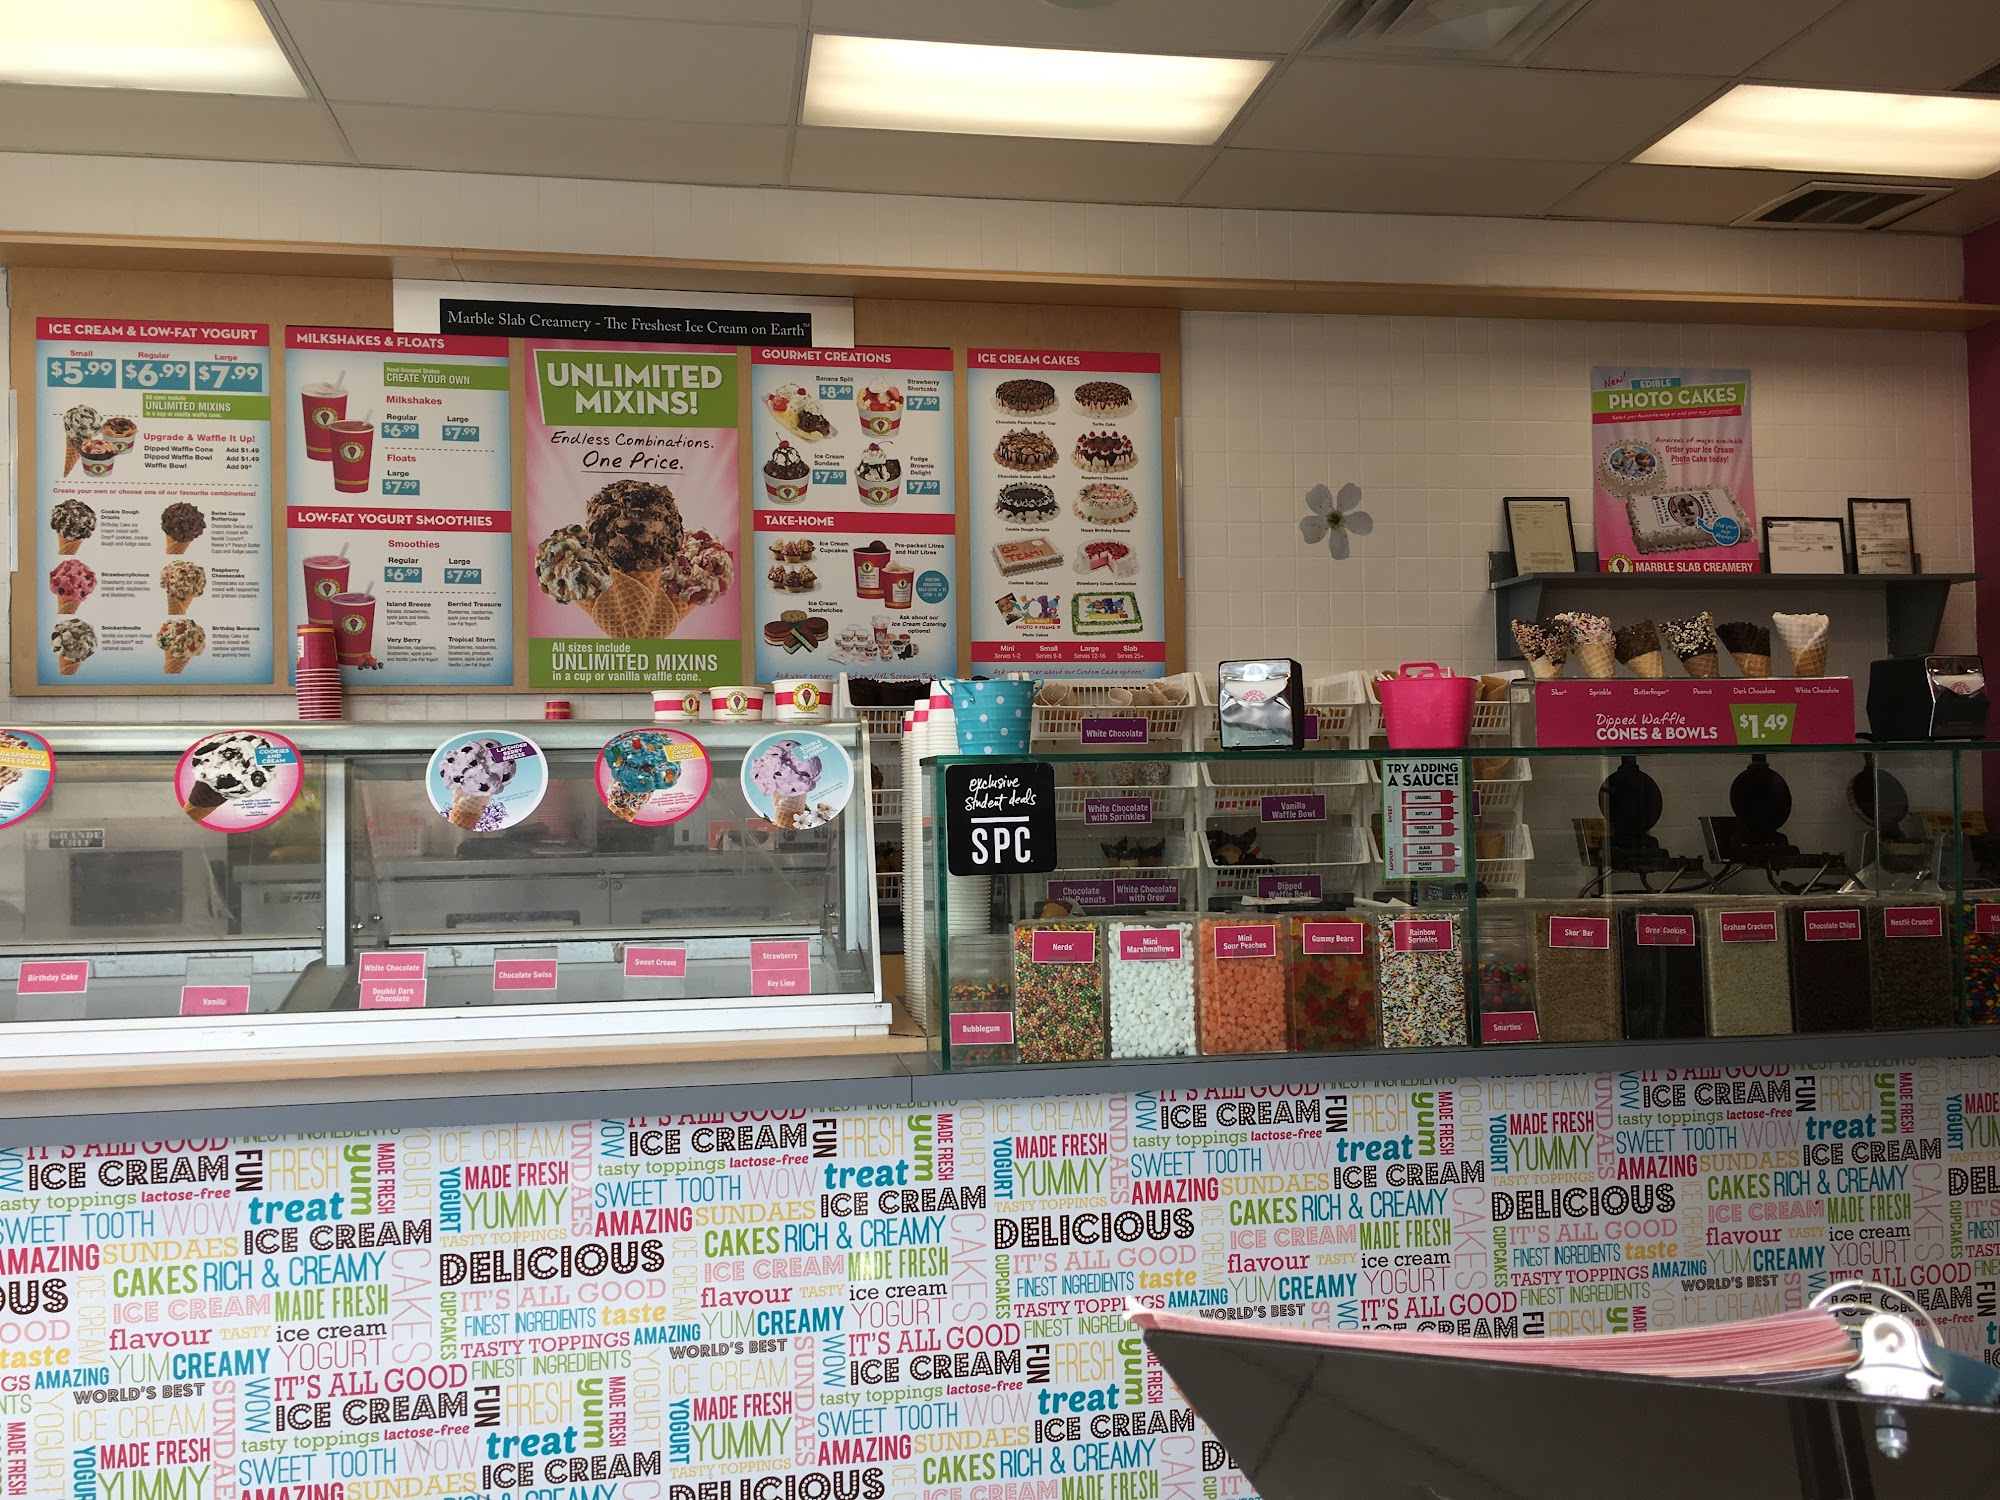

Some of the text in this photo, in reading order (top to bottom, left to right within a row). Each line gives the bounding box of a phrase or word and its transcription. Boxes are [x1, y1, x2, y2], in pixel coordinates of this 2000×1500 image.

[447, 310, 494, 326] Marble
[498, 313, 526, 326] Slab
[530, 314, 592, 332] Creamery
[604, 317, 628, 332] The
[632, 318, 682, 335] Freshest
[685, 320, 704, 334] Ice
[707, 321, 748, 336] Cream
[752, 326, 767, 336] on
[48, 324, 258, 340] ICE CREAM & LOW-FAT YOGURT
[297, 333, 445, 348] MILKSHAKES & FLOATS
[138, 351, 170, 360] Regular
[214, 354, 238, 362] Large
[762, 349, 892, 364] GOURMET CREATIONS
[978, 354, 1080, 366] ICE CREAM CAKES
[50, 360, 112, 385] $5.99
[125, 362, 188, 387] $6.99
[198, 364, 259, 389] $7.99
[548, 363, 722, 389] UNLIMITED
[386, 373, 470, 385] CREATE YOUR OWN
[908, 379, 940, 387] Strawberry
[1604, 371, 1627, 388] New!
[1640, 379, 1672, 389] EDIBLE
[820, 386, 852, 398] $8.49
[386, 395, 443, 405] Milkshakes
[575, 390, 698, 415] MIXINS!
[908, 398, 938, 410] $7.59
[1608, 387, 1737, 410] PHOTO CAKES
[386, 414, 417, 422] Regular
[447, 416, 469, 424] Large
[384, 425, 416, 437] $6.99
[445, 428, 476, 440] $7.99
[143, 433, 184, 442] Upgrade
[197, 434, 227, 442] Waffle
[229, 434, 239, 442] It
[241, 435, 256, 444] Up!
[551, 432, 714, 449] Endless Combinations.
[387, 454, 416, 463] Floats
[583, 451, 684, 470] One Price.
[814, 471, 844, 484] $7.59
[298, 512, 492, 526] LOW-FAT YOGURT SMOOTHIES
[764, 516, 835, 526] TAKE-HOME
[388, 540, 440, 548] Smoothies
[1636, 562, 1753, 572] MARBLE SLAB CREAMERY
[552, 642, 630, 652] All sizes include
[552, 654, 718, 672] UNLIMITED MIXINS
[552, 672, 562, 680] in
[574, 673, 592, 682] cup
[608, 672, 640, 681] vanilla
[644, 671, 672, 682] waffle
[676, 674, 702, 682] cone.
[1588, 687, 1612, 697] Sprinkle
[1692, 687, 1713, 695] Peanut
[1733, 687, 1776, 695] Dark Chocolate
[1794, 686, 1840, 695] White Chocolate
[1596, 712, 1686, 730] Dipped Waffle
[1740, 714, 1788, 740] $1.49
[1086, 729, 1144, 738] White Chocolate
[1596, 726, 1718, 740] CONES & BOWLS
[1386, 762, 1458, 774] TRY ADDING
[969, 774, 1020, 793] exclusive
[1388, 774, 1459, 787] A SAUCE!
[965, 788, 1037, 812] student deals
[1280, 801, 1306, 810] Vanilla
[1088, 802, 1148, 813] White Chocolate
[1091, 812, 1146, 822] with Sprinkles
[1272, 810, 1316, 818] Waffle Bowl
[972, 826, 1031, 865] SPC
[1723, 922, 1774, 932] Graham Crackers
[1809, 921, 1856, 930] Chocolate Chips
[1238, 934, 1252, 942] Mini
[1410, 928, 1436, 936] Rainbow
[1142, 938, 1158, 946] Mini
[1312, 934, 1354, 944] Gummy Bears
[1408, 936, 1438, 944] Sprinkles
[1126, 945, 1174, 953] Marshmallows
[1223, 941, 1267, 950] Sour Peaches
[634, 958, 677, 967] Sweet Cream
[762, 952, 798, 962] Strawberry
[364, 964, 420, 972] White Chocolate
[28, 972, 78, 983] Birthday Cake
[498, 970, 552, 980] Chocolate Swiss
[767, 978, 796, 988] Key Lime
[962, 1024, 1001, 1034] Bubblegum
[598, 1158, 726, 1179] tasty toppings
[344, 1144, 372, 1216] yum
[141, 1188, 231, 1203] lactose-free
[248, 1192, 345, 1226] treat
[462, 1186, 568, 1232] YUMMY
[704, 1227, 780, 1257] CAKES
[1624, 1241, 1678, 1261] taste
[439, 1239, 664, 1287] DELICIOUS
[1652, 1260, 1706, 1278] AMAZING
[1279, 1273, 1358, 1300] CREAMY
[109, 1328, 213, 1351] flavour
[74, 1382, 206, 1405] WORLD'S BEST
